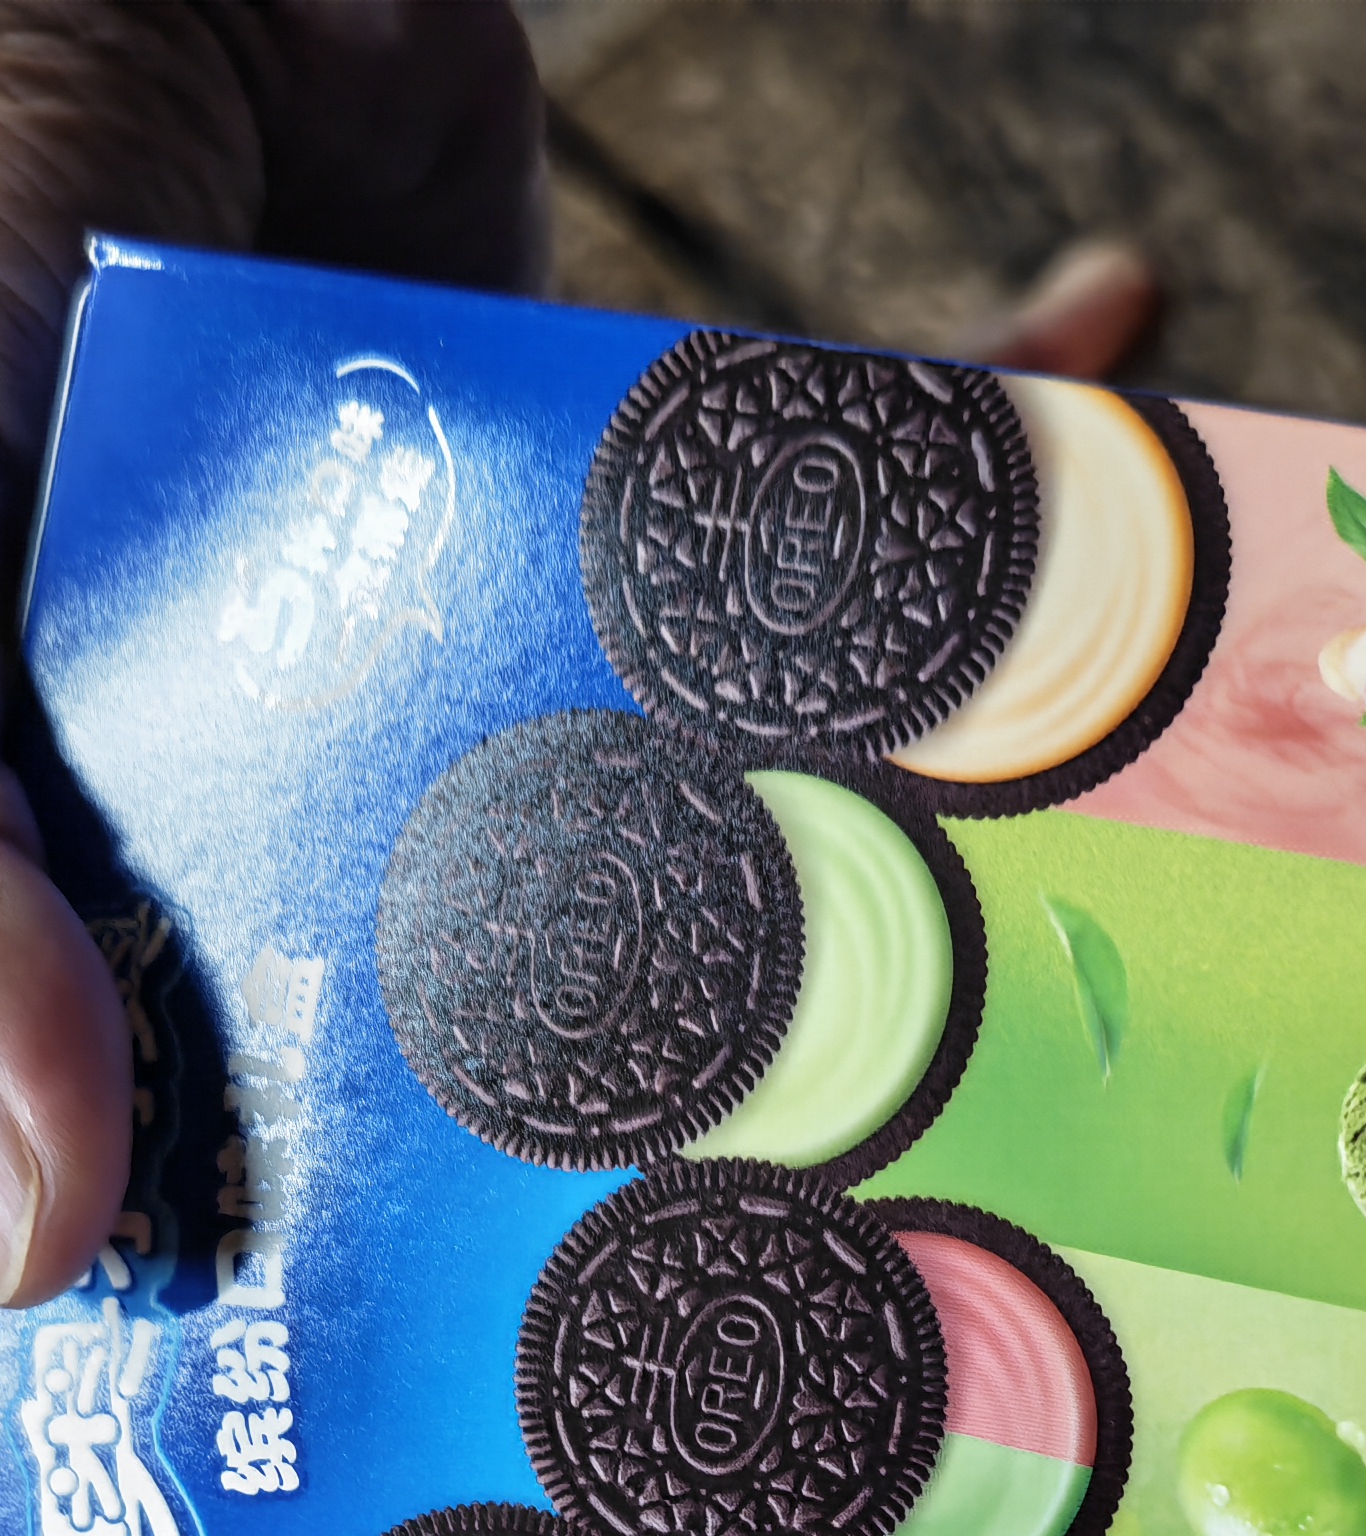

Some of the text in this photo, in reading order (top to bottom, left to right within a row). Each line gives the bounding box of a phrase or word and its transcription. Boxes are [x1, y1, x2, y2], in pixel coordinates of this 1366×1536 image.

[770, 458, 839, 612] OREO
[555, 871, 617, 1017] OREO
[695, 1313, 760, 1452] OREO
